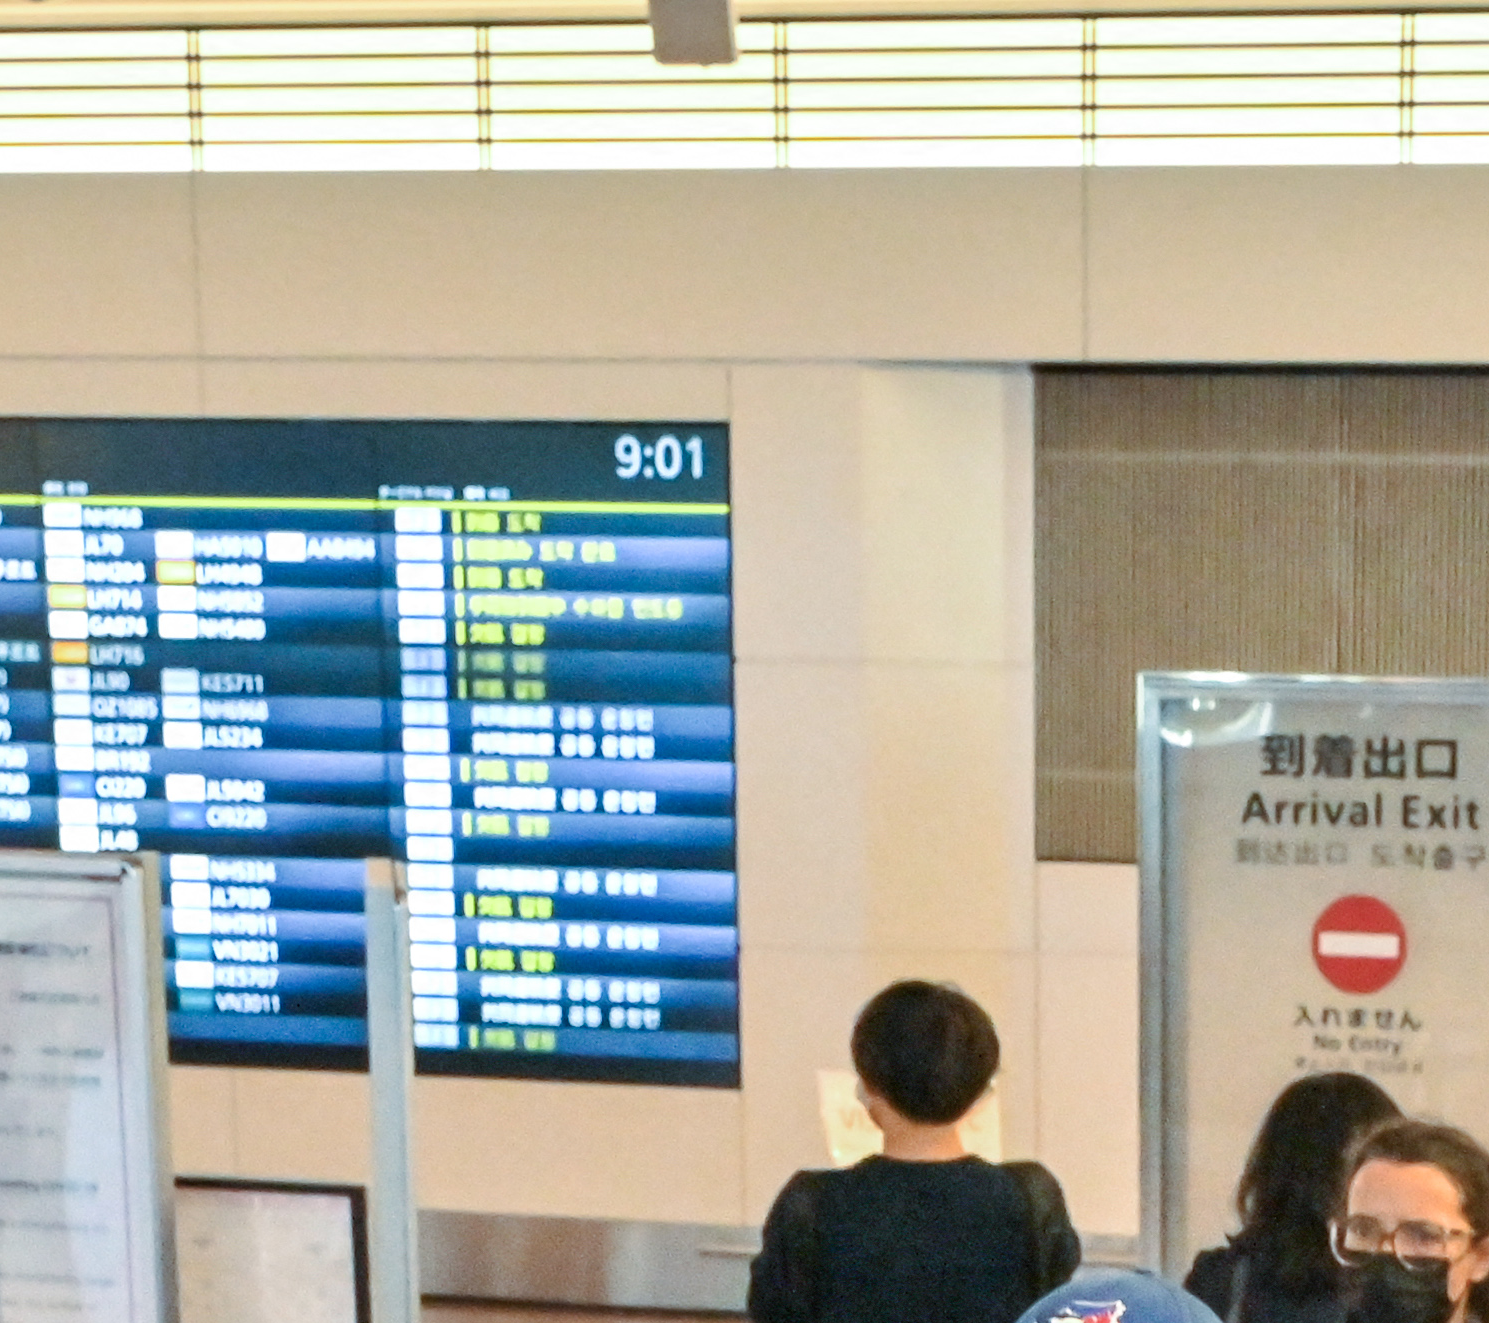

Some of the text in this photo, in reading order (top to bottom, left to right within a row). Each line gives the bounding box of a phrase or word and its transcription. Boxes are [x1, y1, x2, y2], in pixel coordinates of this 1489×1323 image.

[613, 434, 705, 480] 9:01
[1260, 735, 1458, 779] 到着出口
[1242, 792, 1481, 830] Arrival Exit
[1294, 1005, 1422, 1031] 入れません
